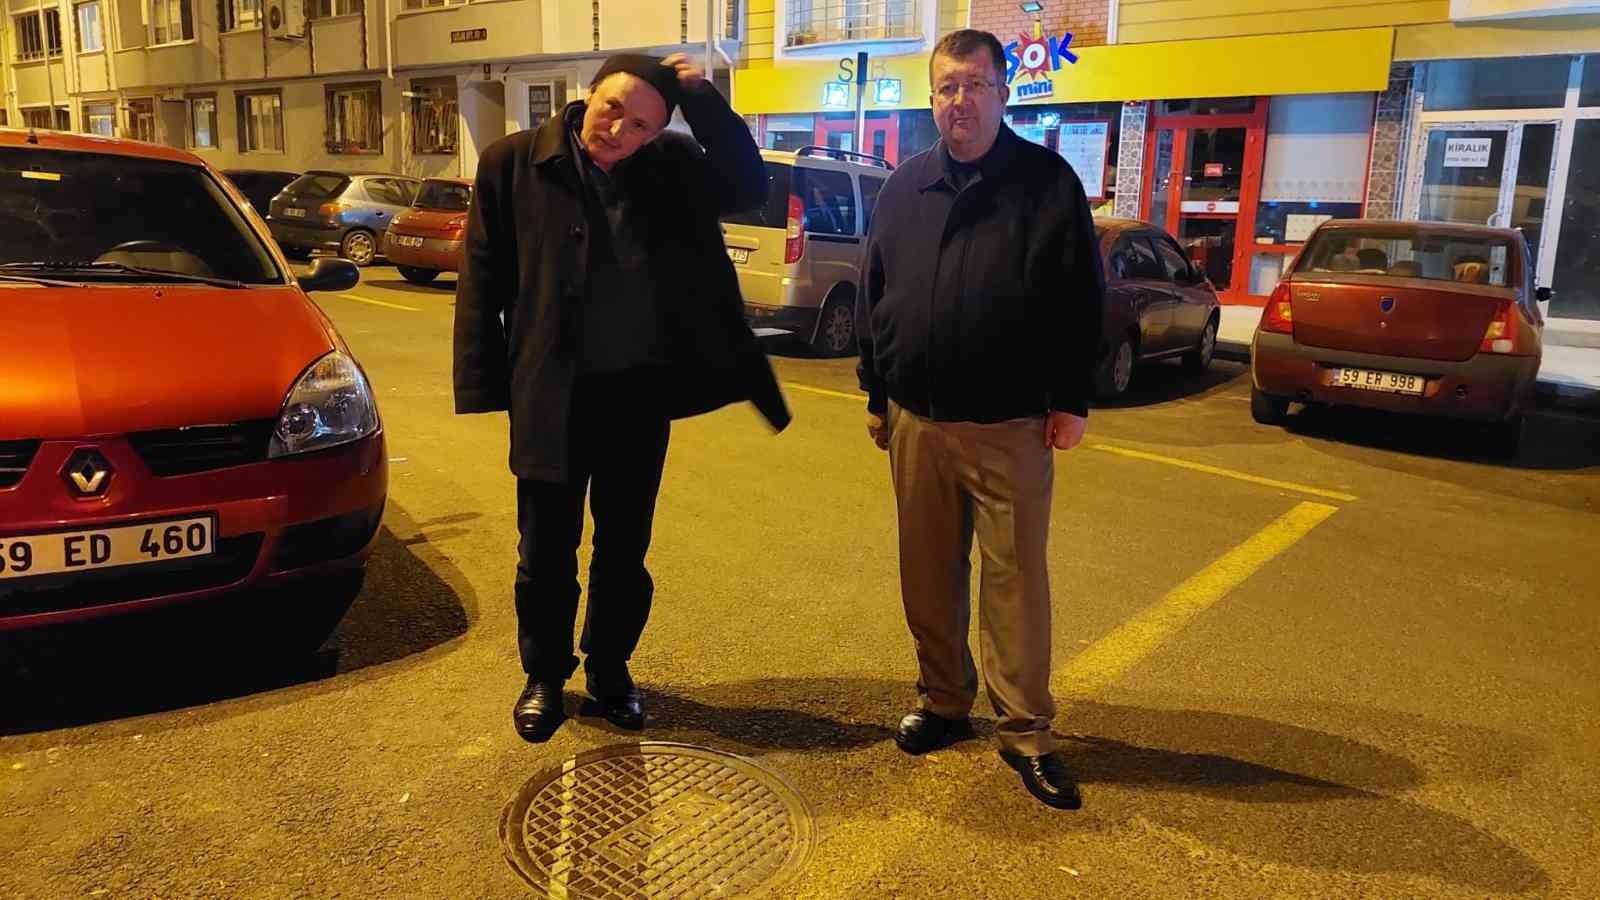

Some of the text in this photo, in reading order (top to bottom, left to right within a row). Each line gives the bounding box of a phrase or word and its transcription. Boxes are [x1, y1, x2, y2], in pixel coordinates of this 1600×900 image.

[1004, 32, 1078, 84] ŞOK
[1017, 79, 1052, 96] mini
[1343, 369, 1360, 382] 59
[1366, 371, 1383, 384] ER
[1390, 374, 1415, 389] 998
[64, 533, 111, 567] ED
[140, 523, 206, 557] 460
